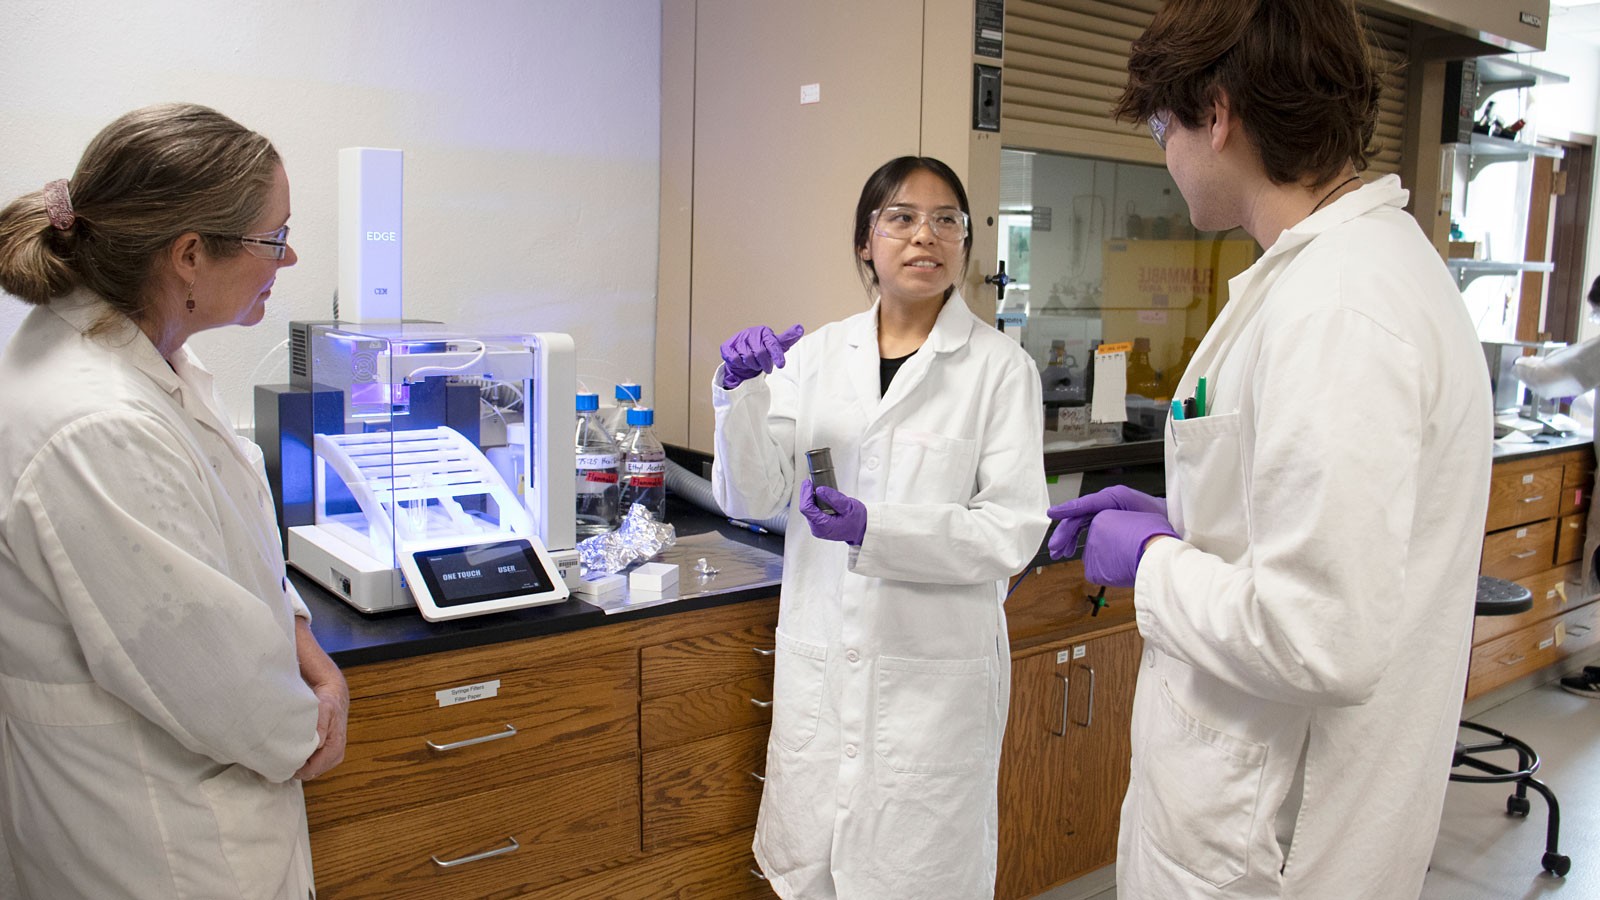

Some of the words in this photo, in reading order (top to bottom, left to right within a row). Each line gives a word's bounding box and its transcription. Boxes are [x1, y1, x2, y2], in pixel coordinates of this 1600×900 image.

[366, 231, 396, 241] EDGE
[628, 463, 643, 473] Ethyl
[498, 565, 516, 573] USER
[442, 573, 456, 581] ONE
[457, 570, 481, 578] TOUCH
[451, 687, 470, 696] Syringe
